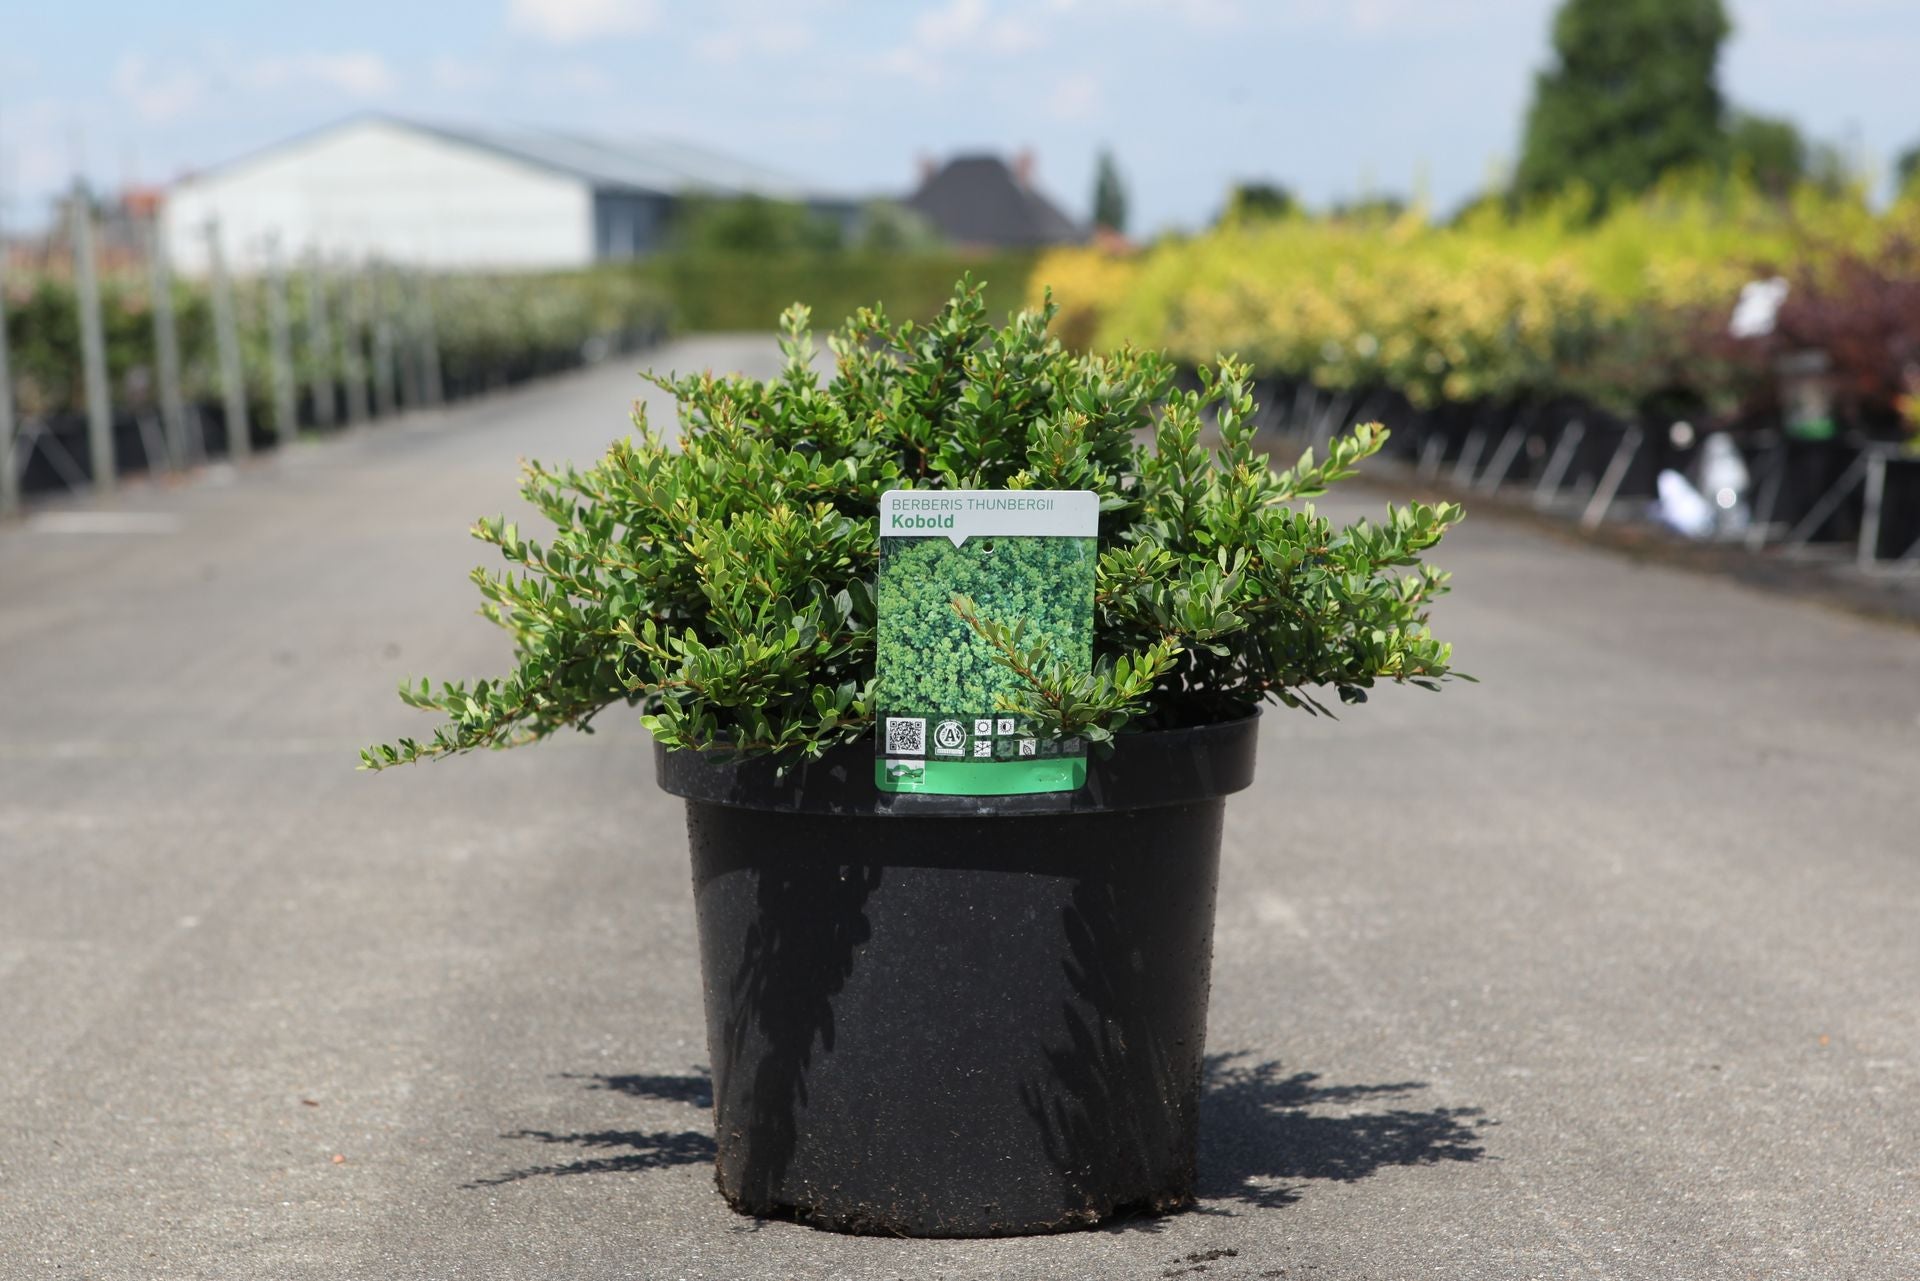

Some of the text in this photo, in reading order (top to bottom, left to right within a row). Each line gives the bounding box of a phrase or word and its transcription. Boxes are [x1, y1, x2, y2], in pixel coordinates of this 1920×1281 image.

[892, 498, 1054, 511] BERBERIS THUNBERGII
[892, 513, 954, 529] Kobold
[944, 728, 956, 742] A
